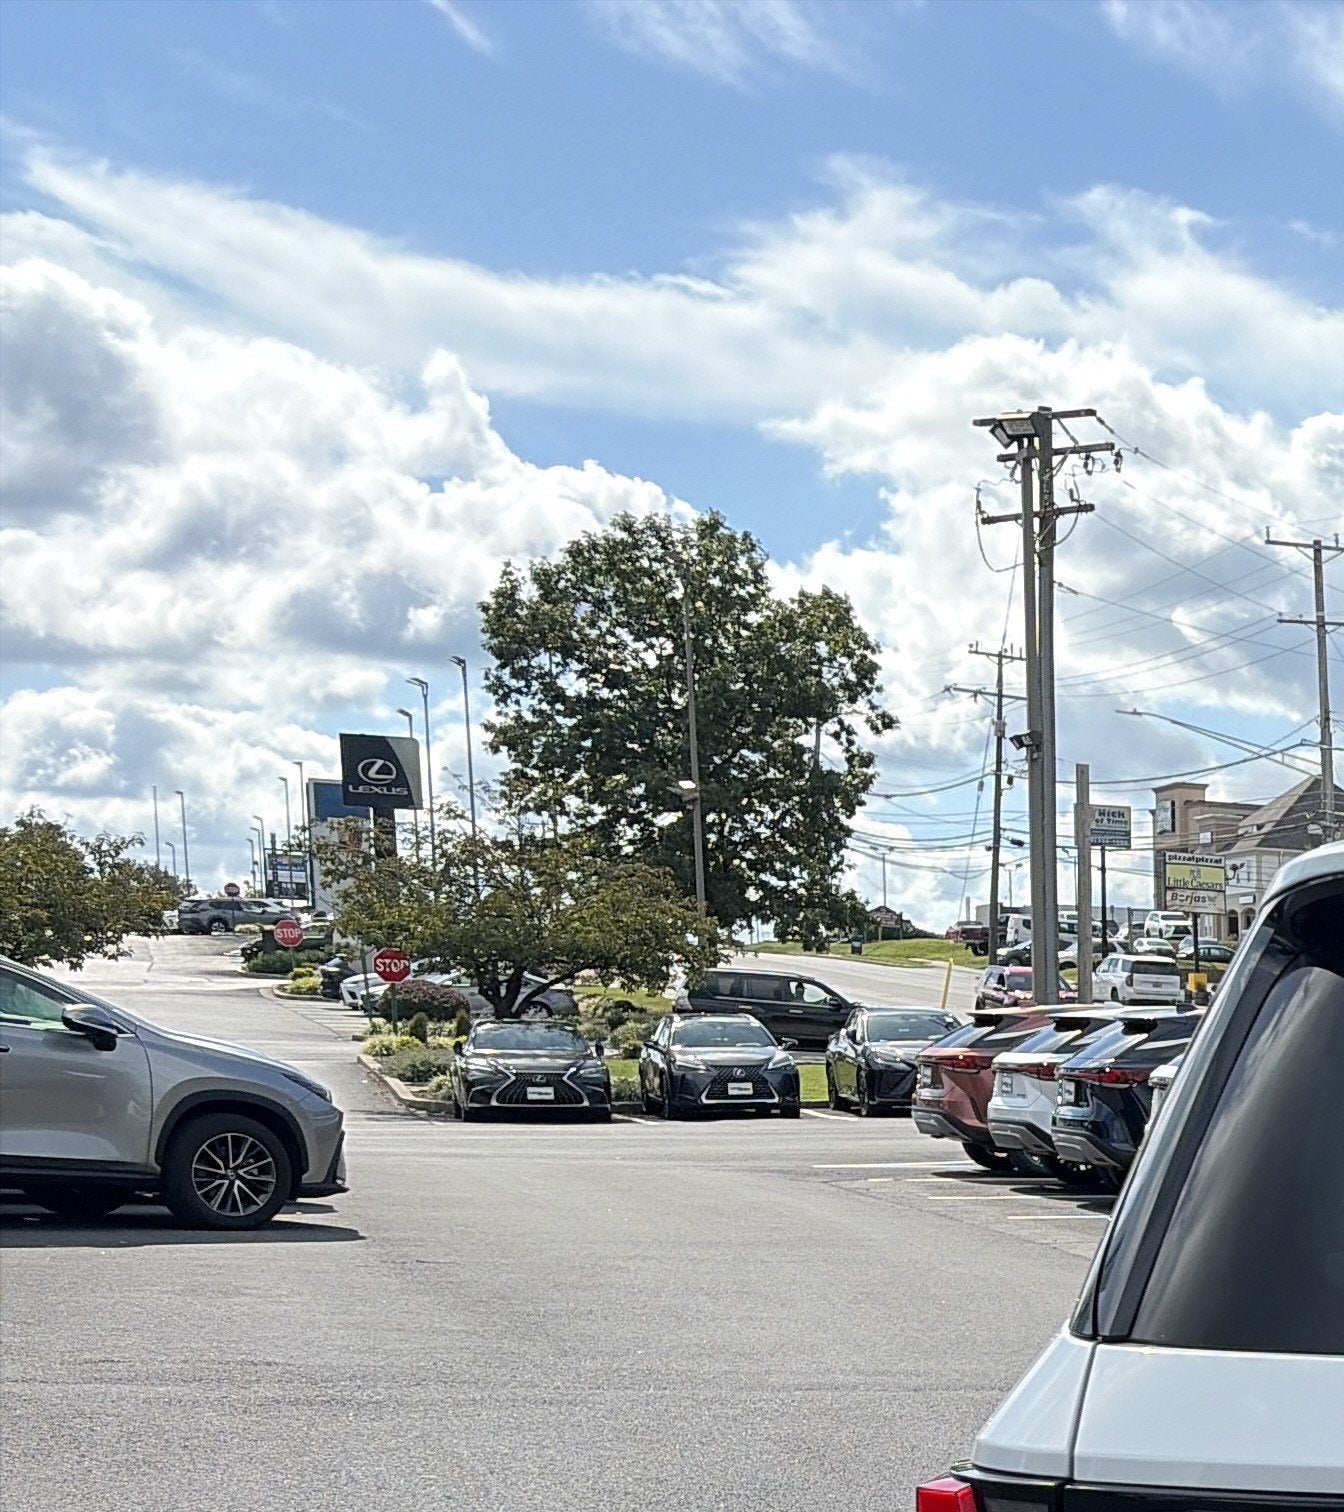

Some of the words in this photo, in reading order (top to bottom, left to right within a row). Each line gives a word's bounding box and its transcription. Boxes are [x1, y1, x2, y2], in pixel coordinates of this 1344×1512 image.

[348, 784, 409, 796] LEXUS
[1168, 876, 1190, 887] Little
[1190, 878, 1224, 890] Caesars
[276, 928, 302, 939] STOP
